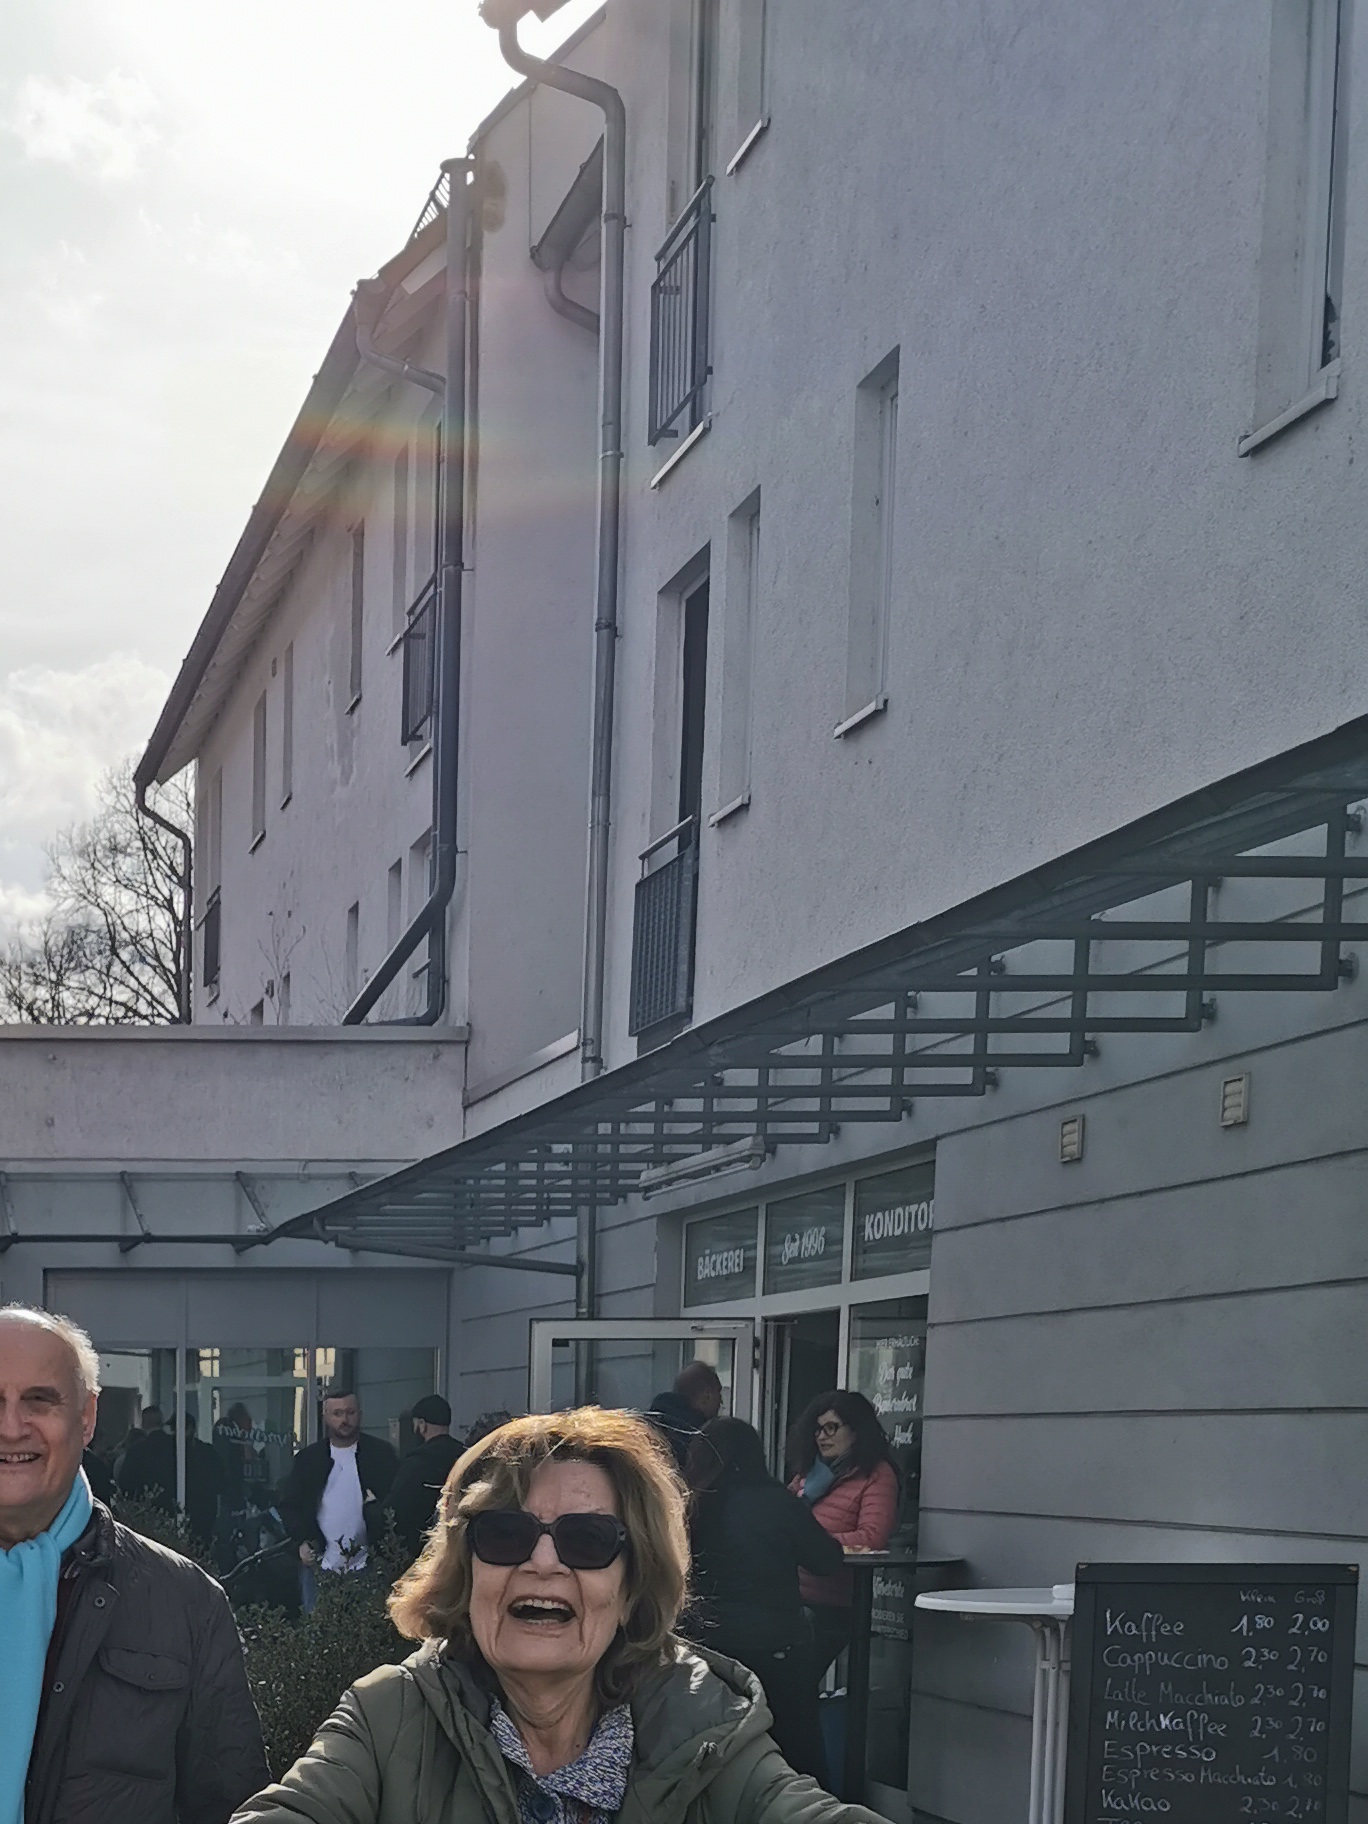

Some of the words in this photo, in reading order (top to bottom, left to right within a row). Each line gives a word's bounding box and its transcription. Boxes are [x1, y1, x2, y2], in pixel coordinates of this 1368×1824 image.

[800, 1225, 825, 1259] 1996
[697, 1248, 744, 1281] BÄCKEREI
[1105, 1607, 1186, 1643] Kaffee
[1102, 1645, 1230, 1676] Cappuccino
[1103, 1740, 1217, 1769] Espresso
[1101, 1764, 1195, 1789] Espresso
